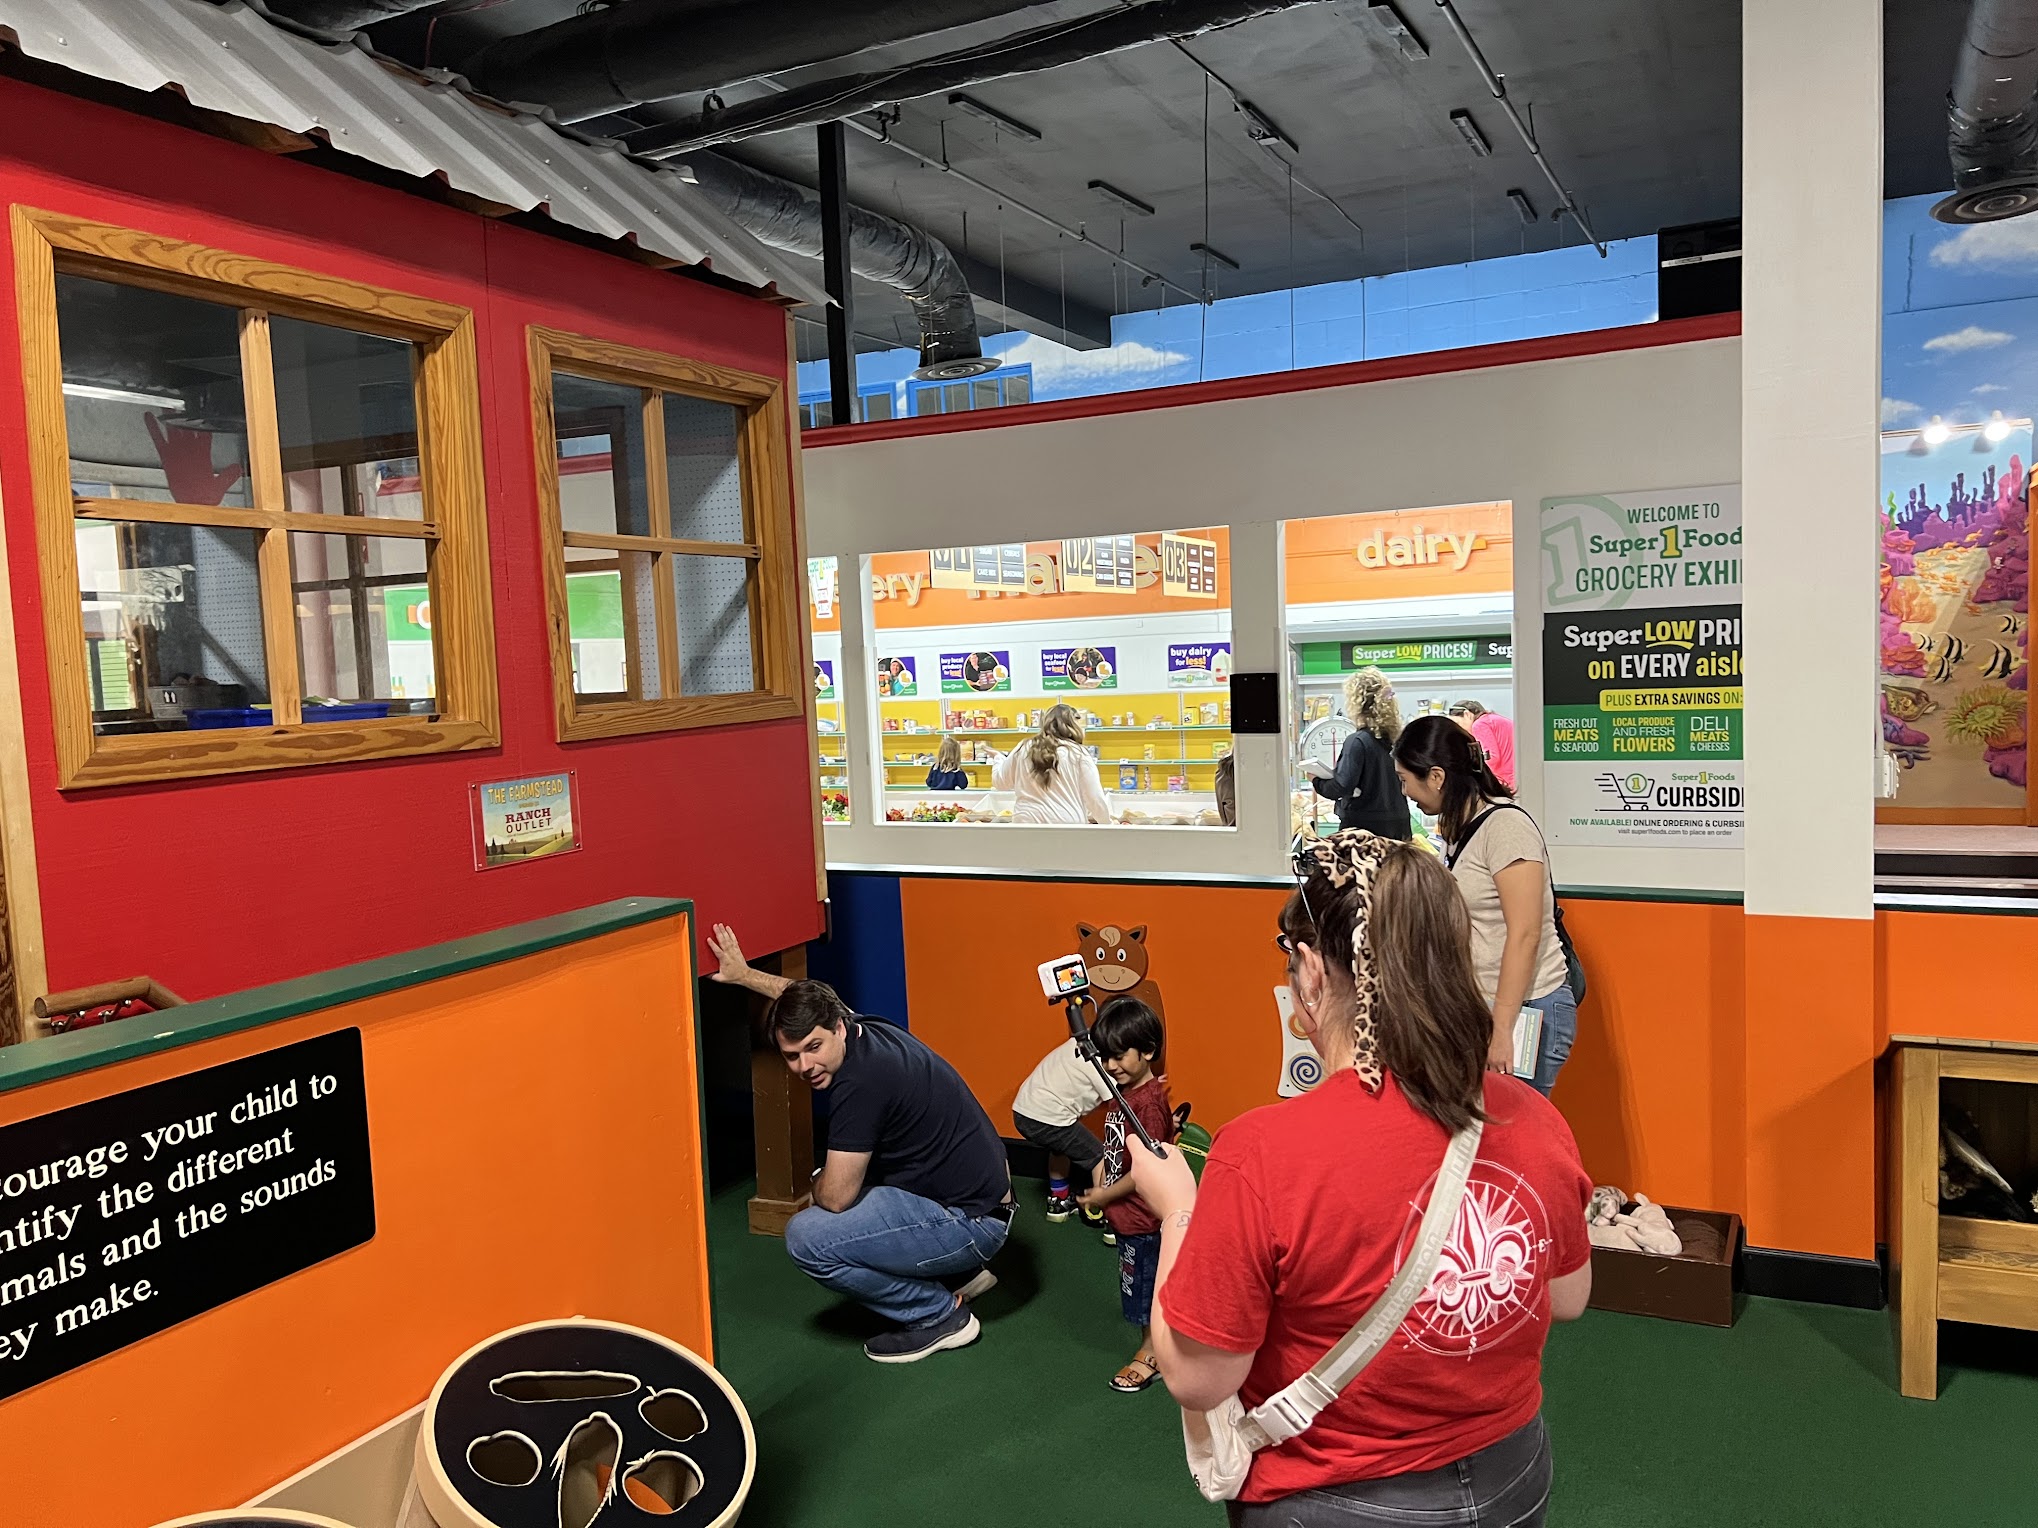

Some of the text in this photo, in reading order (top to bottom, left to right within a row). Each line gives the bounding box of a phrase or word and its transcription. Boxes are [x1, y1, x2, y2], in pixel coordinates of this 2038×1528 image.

[1627, 502, 1720, 524] WELCOME TO
[1356, 525, 1477, 571] dairy
[1589, 535, 1659, 557] Super
[1660, 525, 1683, 559] 1
[1165, 546, 1185, 578] 03
[1576, 558, 1742, 593] GROCERY EXHI
[1563, 618, 1740, 652] Super LOW PRI
[1170, 646, 1212, 658] buy dairy
[1355, 642, 1473, 662] Super LOW PRICES!
[1174, 656, 1206, 666] for less!
[1588, 650, 1743, 680] on EVERY aisl
[1605, 691, 1743, 706] PLUS EXTRA SAVINGS ON:
[1553, 717, 1598, 729] FRESH CUT
[1612, 716, 1675, 727] LOCAL PRODUCE
[1690, 716, 1729, 731] DELI
[1554, 729, 1599, 741] MEATS
[1612, 726, 1675, 737] AND FRESH
[1690, 731, 1730, 742] MEATS
[1310, 742, 1316, 750] 8
[1553, 741, 1599, 753] & SEAFOOD
[1613, 736, 1675, 753] FLOWERS
[1689, 741, 1730, 751] & CHEESES
[1671, 771, 1735, 784] Super 1 Foods
[488, 779, 563, 804] THE FARMSTEAD
[1656, 786, 1744, 808] CURBSID
[505, 807, 551, 824] RANCH
[1569, 818, 1589, 826] NOW
[1589, 818, 1632, 827] AVAILABLE!
[1633, 819, 1661, 827] ONLINE
[1662, 819, 1703, 827] ORDERING
[1712, 820, 1744, 828] CURBSI
[506, 817, 552, 834] OUTLET
[141, 1111, 218, 1162] your
[230, 1079, 298, 1125] child
[308, 1074, 338, 1100] to
[97, 1180, 155, 1219] the
[167, 1127, 296, 1193] different
[102, 1218, 162, 1267] and
[175, 1201, 228, 1239] the
[240, 1158, 337, 1215] sounds
[55, 1277, 160, 1337] make.
